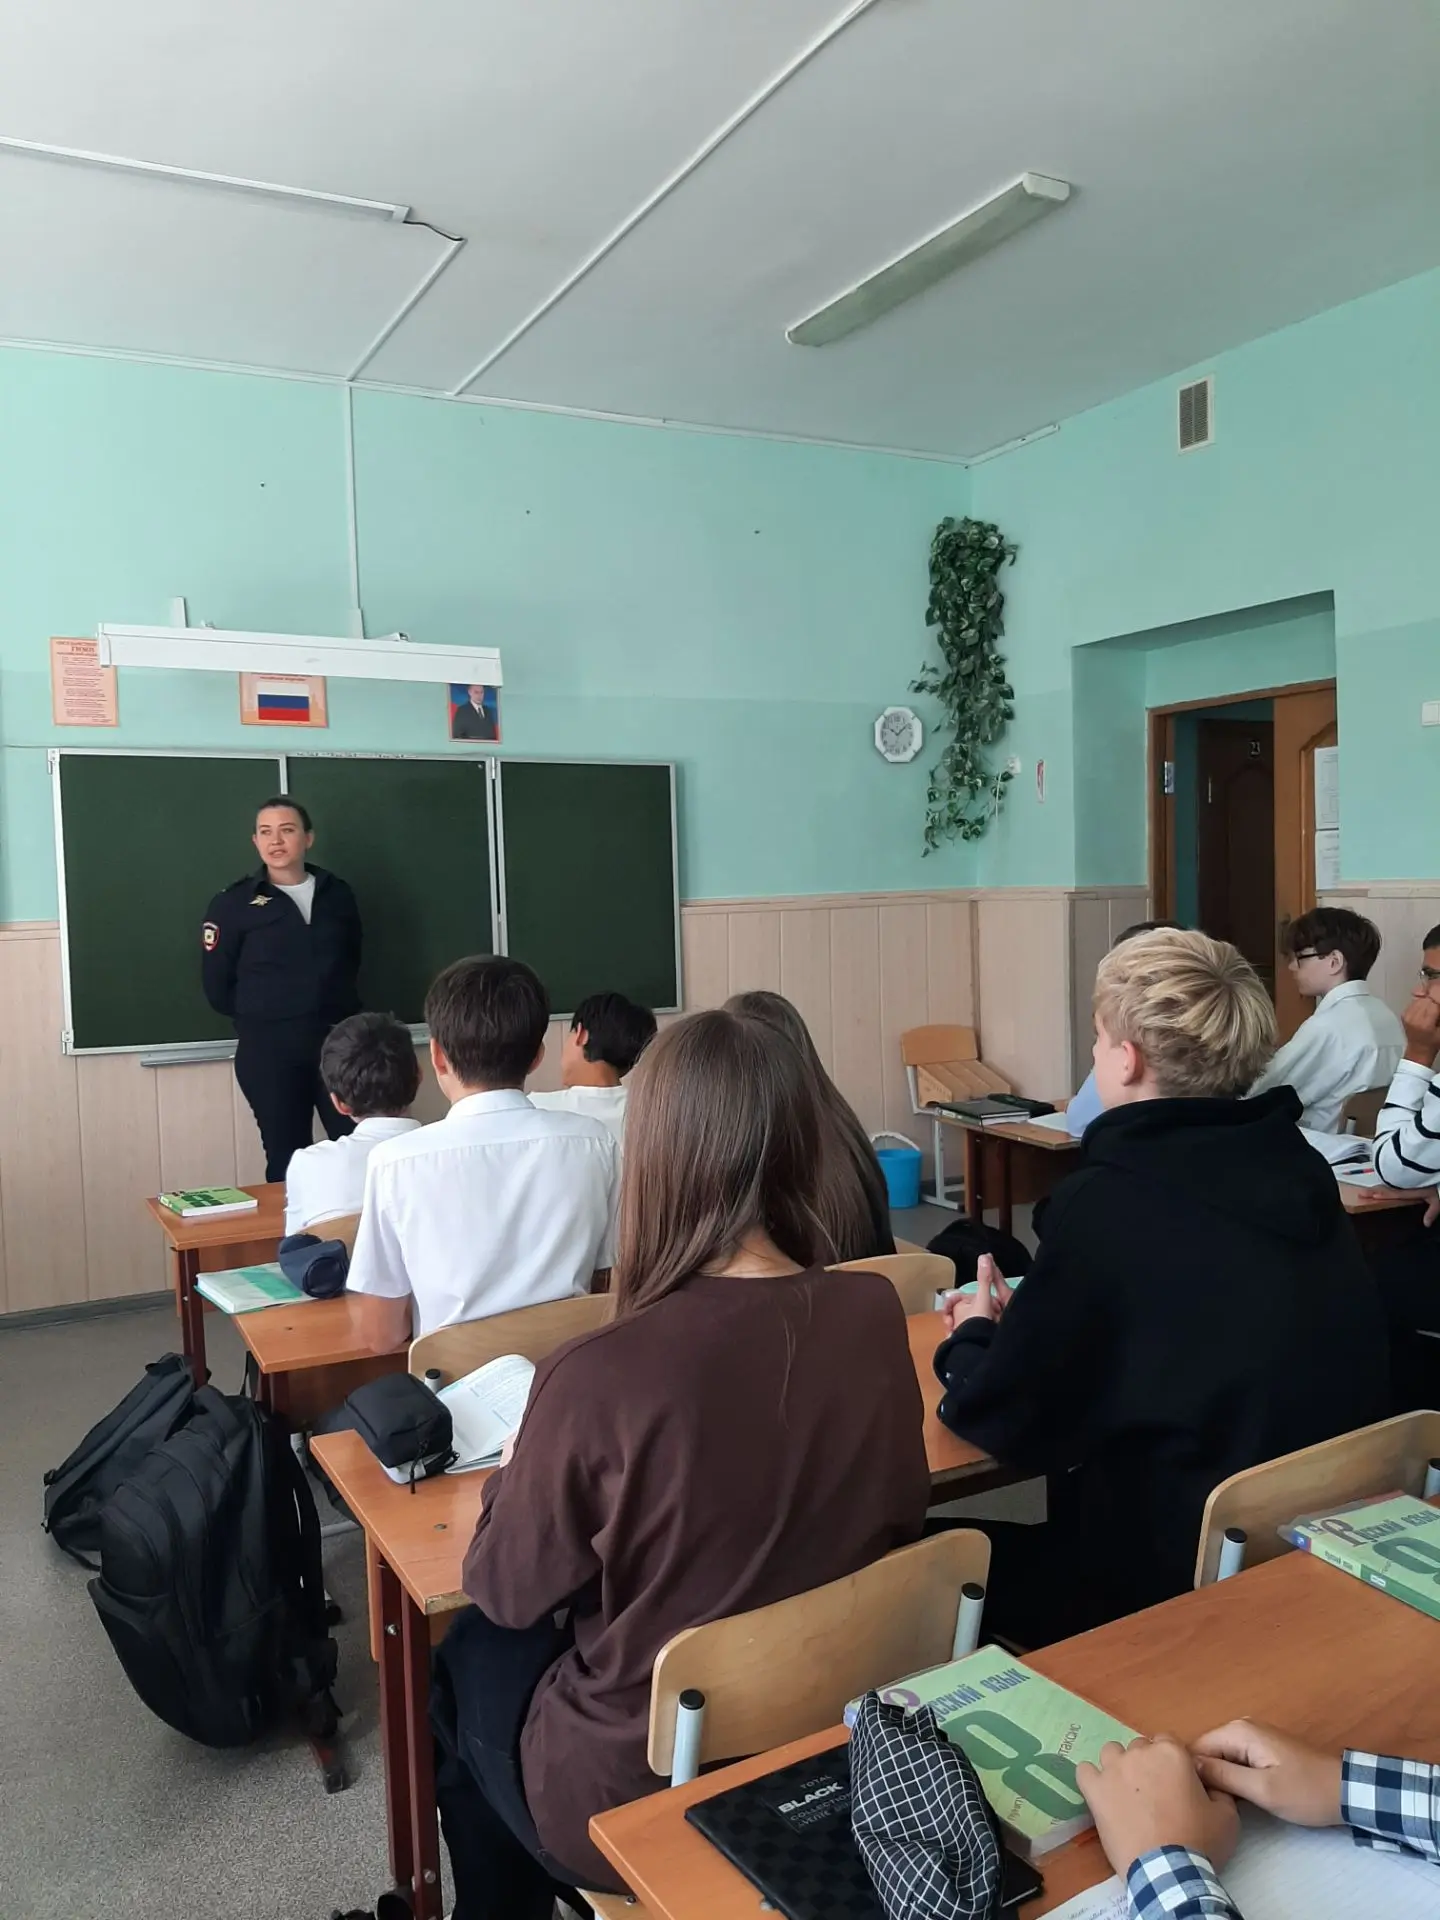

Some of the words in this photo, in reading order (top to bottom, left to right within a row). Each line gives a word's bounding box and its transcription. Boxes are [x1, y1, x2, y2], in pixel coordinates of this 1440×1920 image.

[979, 1667, 1032, 1694] язык
[942, 1709, 1086, 1821] 8
[778, 1781, 844, 1813] BLACK
